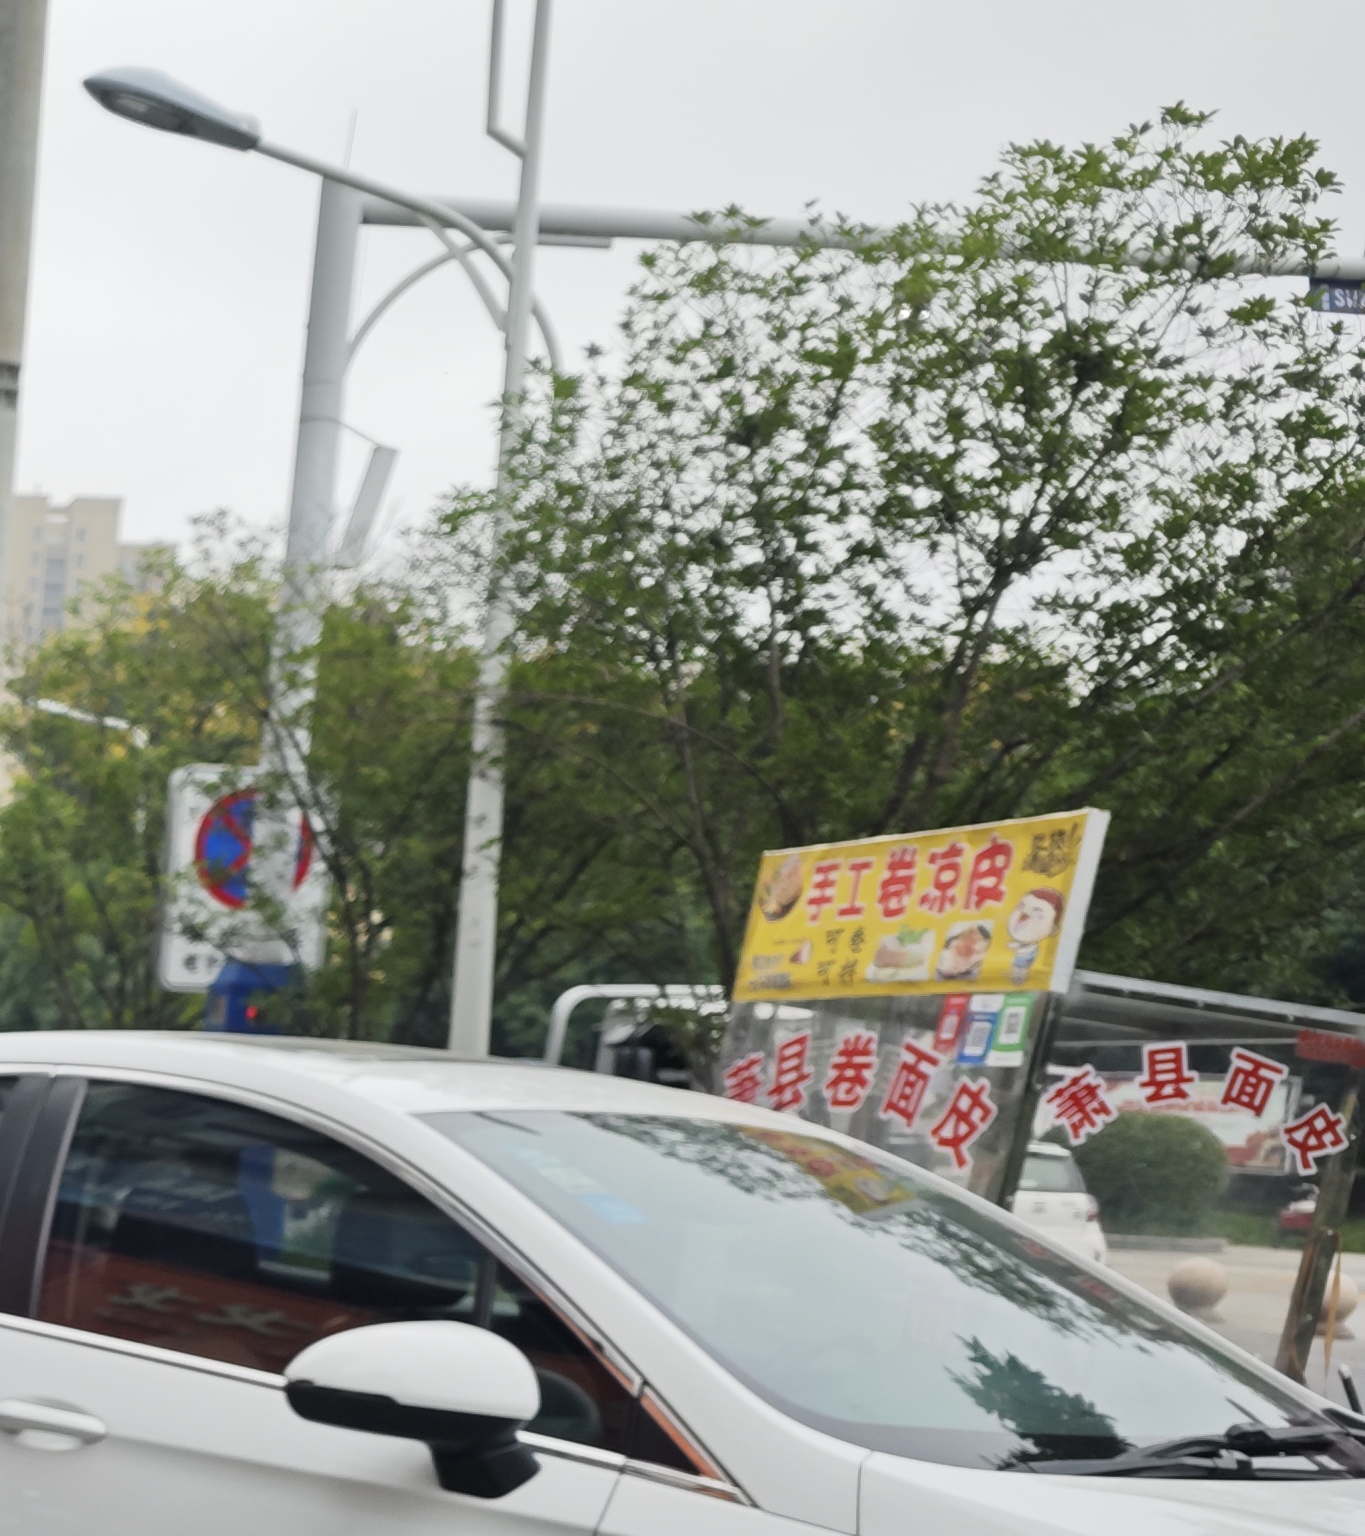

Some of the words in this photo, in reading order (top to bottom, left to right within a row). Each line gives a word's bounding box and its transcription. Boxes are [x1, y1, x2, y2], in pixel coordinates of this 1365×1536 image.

[723, 1030, 998, 1171] 萧县卷面皮
[1044, 1044, 1349, 1172] 萧县面皮
